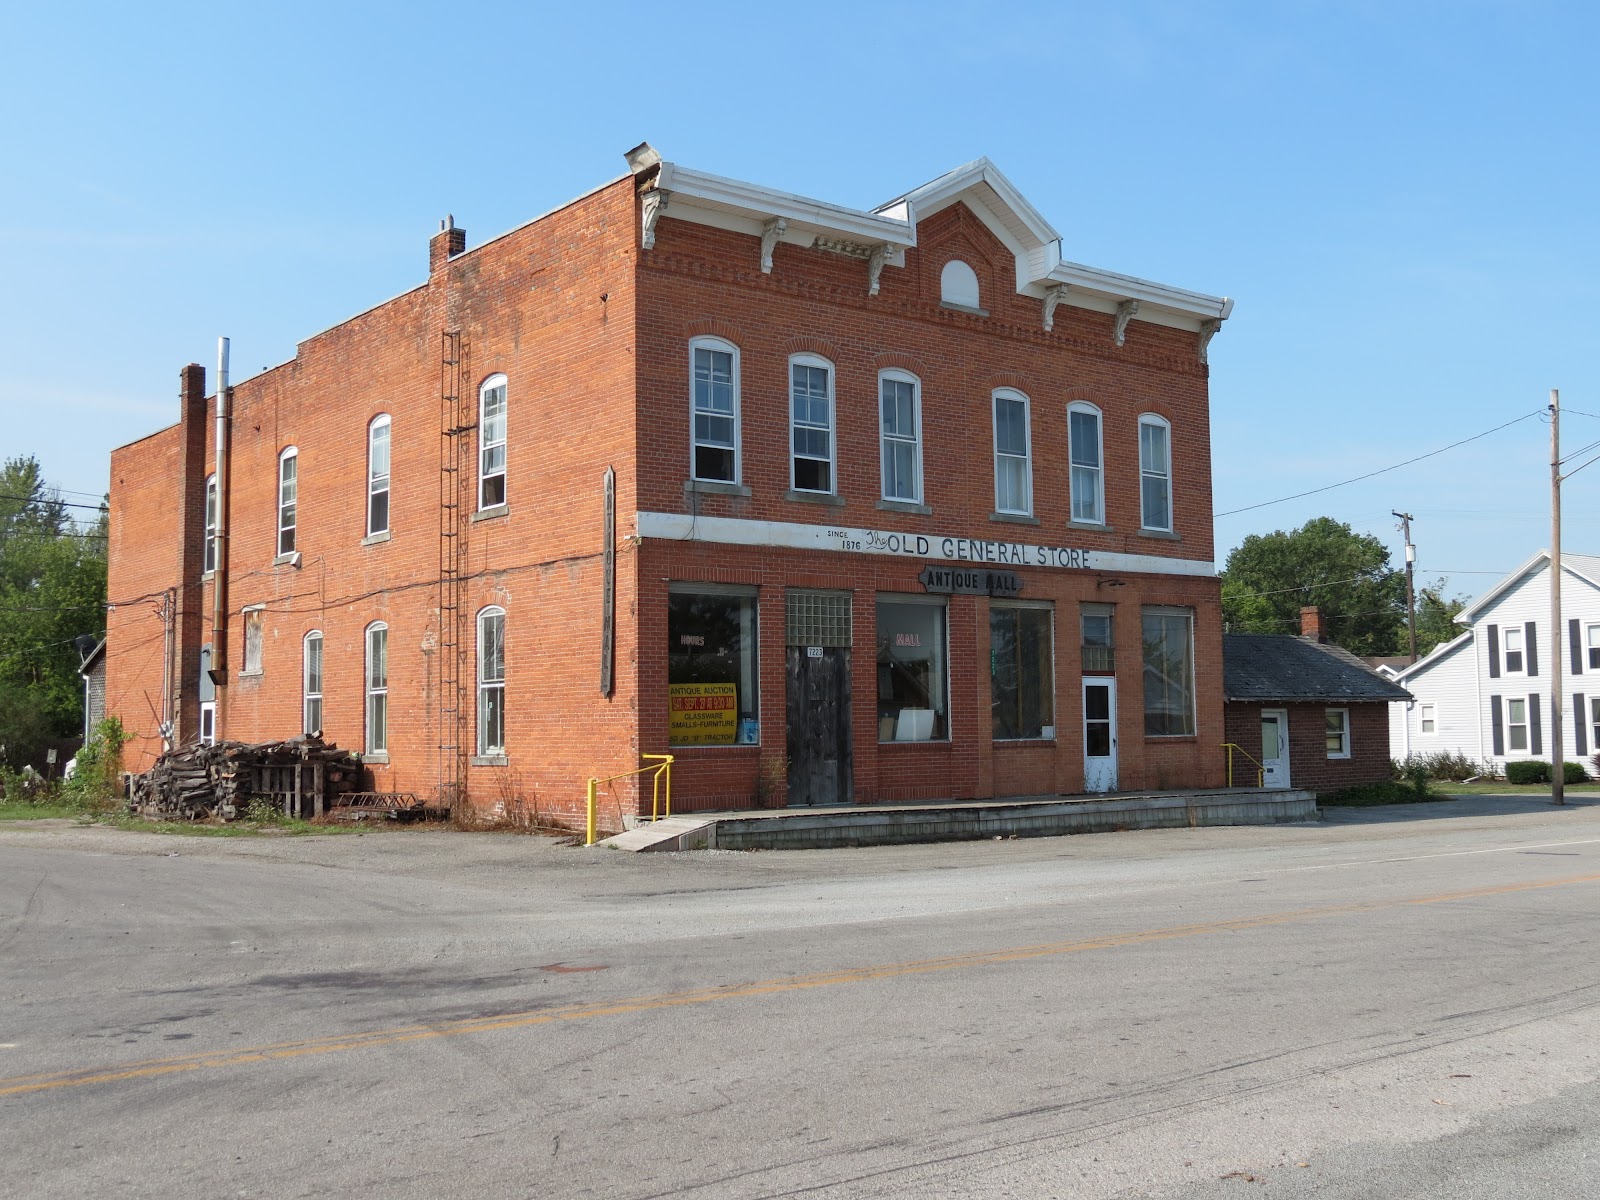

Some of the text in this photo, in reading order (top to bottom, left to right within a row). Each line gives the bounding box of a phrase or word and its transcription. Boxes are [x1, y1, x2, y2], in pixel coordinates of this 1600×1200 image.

[827, 530, 849, 539] SINCE
[842, 540, 861, 550] 1876
[865, 530, 1091, 569] The OLD GENERAL STORE
[927, 570, 978, 591] ANTIQUE
[681, 635, 705, 646] HOURS
[895, 633, 921, 647] MALL
[808, 648, 823, 656] 7223
[670, 686, 734, 695] ANTIQUE AUCTION
[684, 712, 723, 720] GLASSWARE
[671, 720, 735, 729] SMALLS-FURNITURE
[704, 733, 734, 741] TRACTOR
